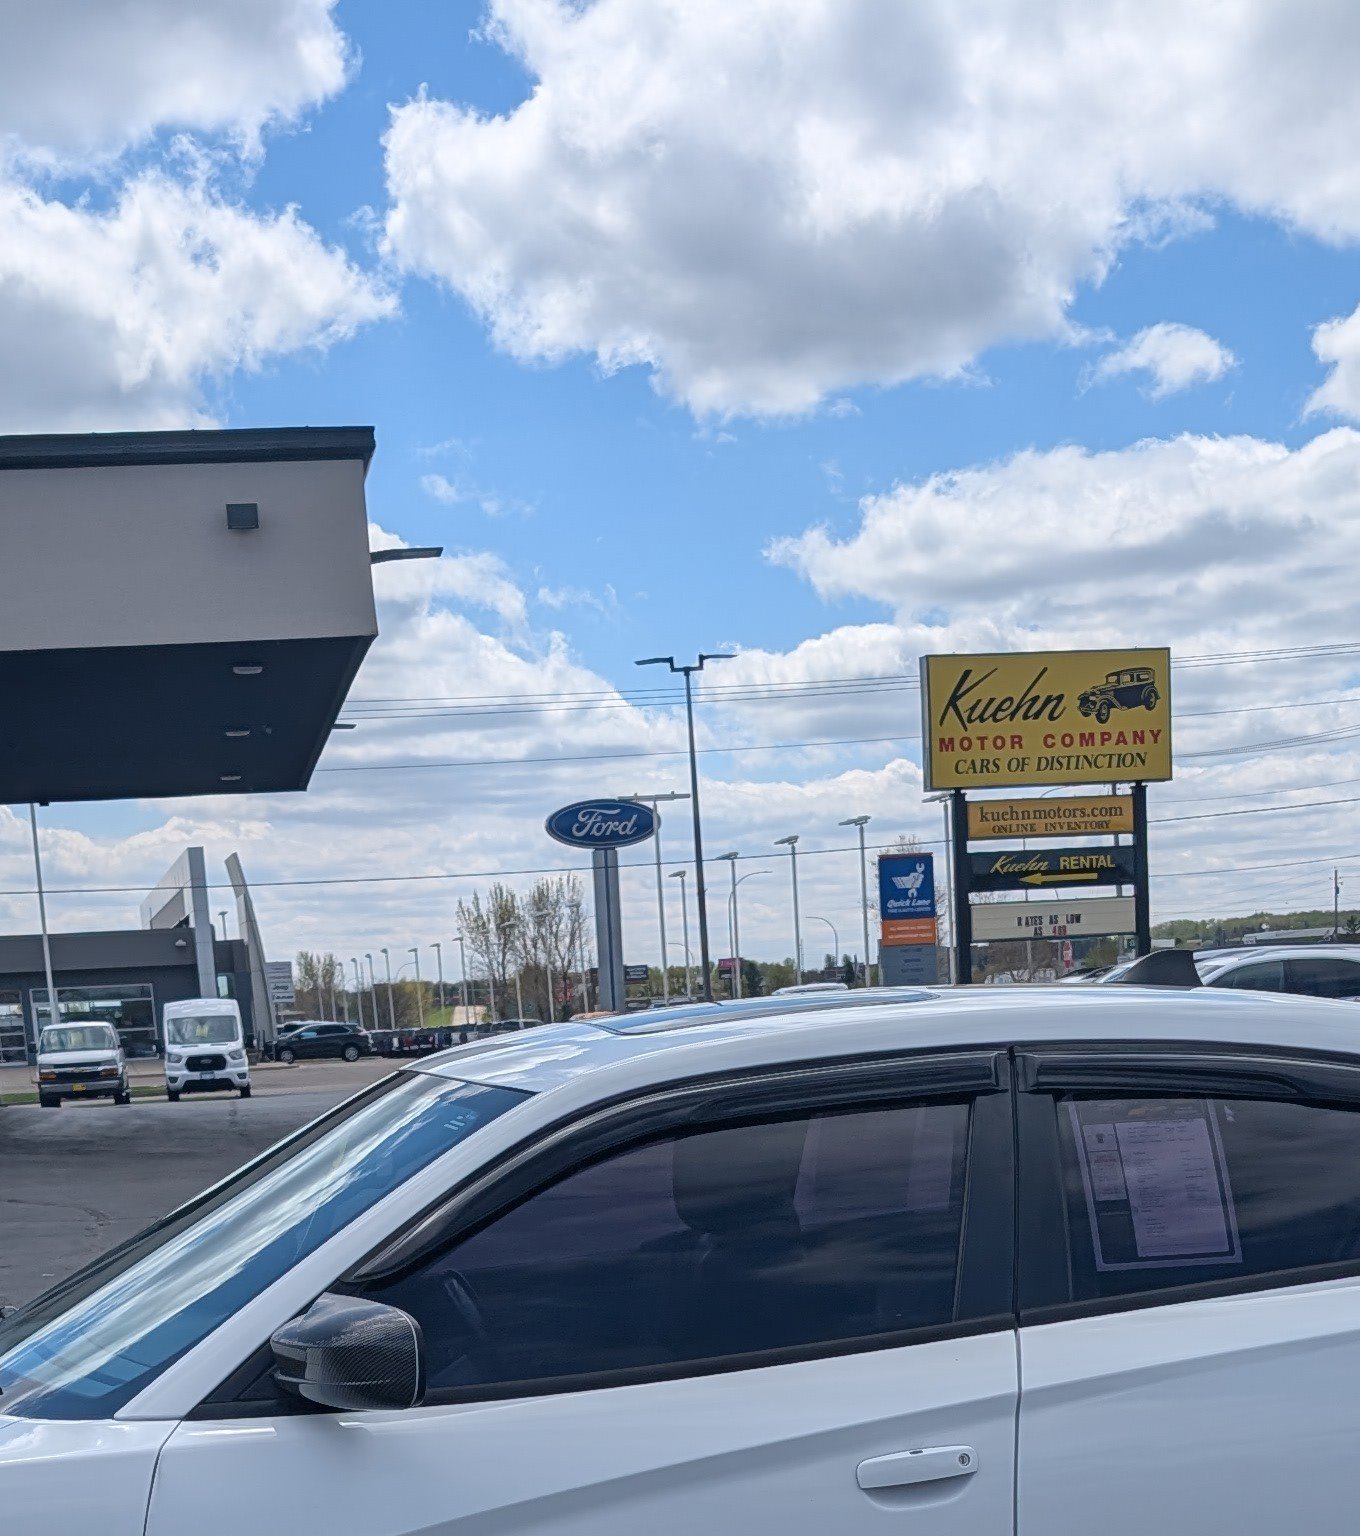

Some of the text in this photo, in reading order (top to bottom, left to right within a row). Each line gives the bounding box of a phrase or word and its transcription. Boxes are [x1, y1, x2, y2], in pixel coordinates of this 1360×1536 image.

[939, 667, 1067, 732] Kuehn
[938, 729, 1162, 752] MOTOR COMPANY
[954, 752, 1148, 775] CARS OF DISTINCTION
[571, 808, 638, 837] Ford
[979, 804, 1124, 823] kuehnmotors.com
[992, 819, 1111, 835] ONLINE INVENTORY
[990, 853, 1116, 875] Kuehn RENTAL
